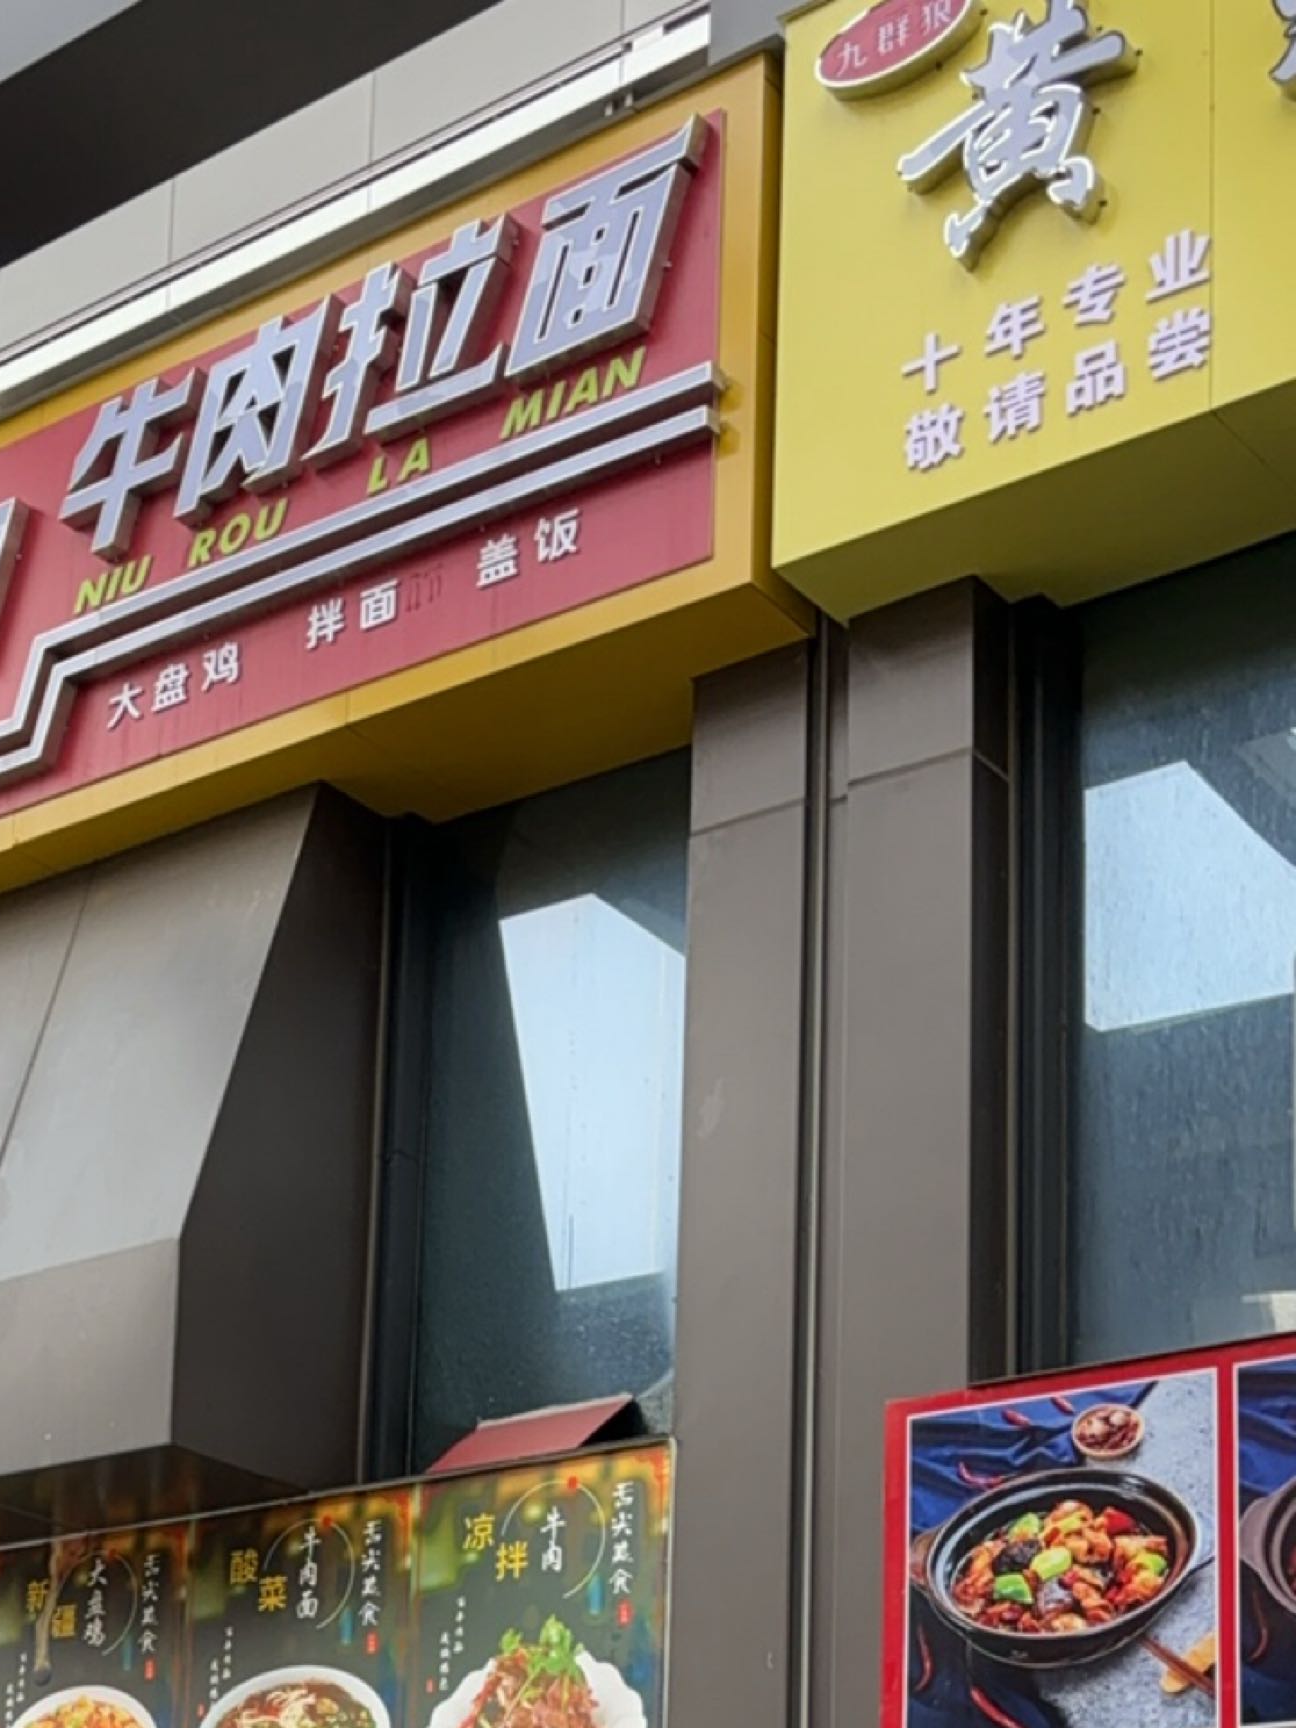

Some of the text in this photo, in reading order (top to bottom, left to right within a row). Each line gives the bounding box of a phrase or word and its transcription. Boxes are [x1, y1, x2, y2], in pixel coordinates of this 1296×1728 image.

[897, 0, 1132, 266] 黄
[60, 112, 708, 556] 牛肉拉面
[902, 229, 1211, 394] 十年专业
[903, 308, 1211, 472] 敬请品尝
[73, 555, 154, 614] NIU
[188, 499, 288, 569] ROU
[366, 439, 433, 497] LA
[498, 346, 647, 441] MIAN
[106, 641, 244, 730] 大盘鸡
[304, 577, 400, 652] 拌面
[475, 507, 583, 589] 盖饭
